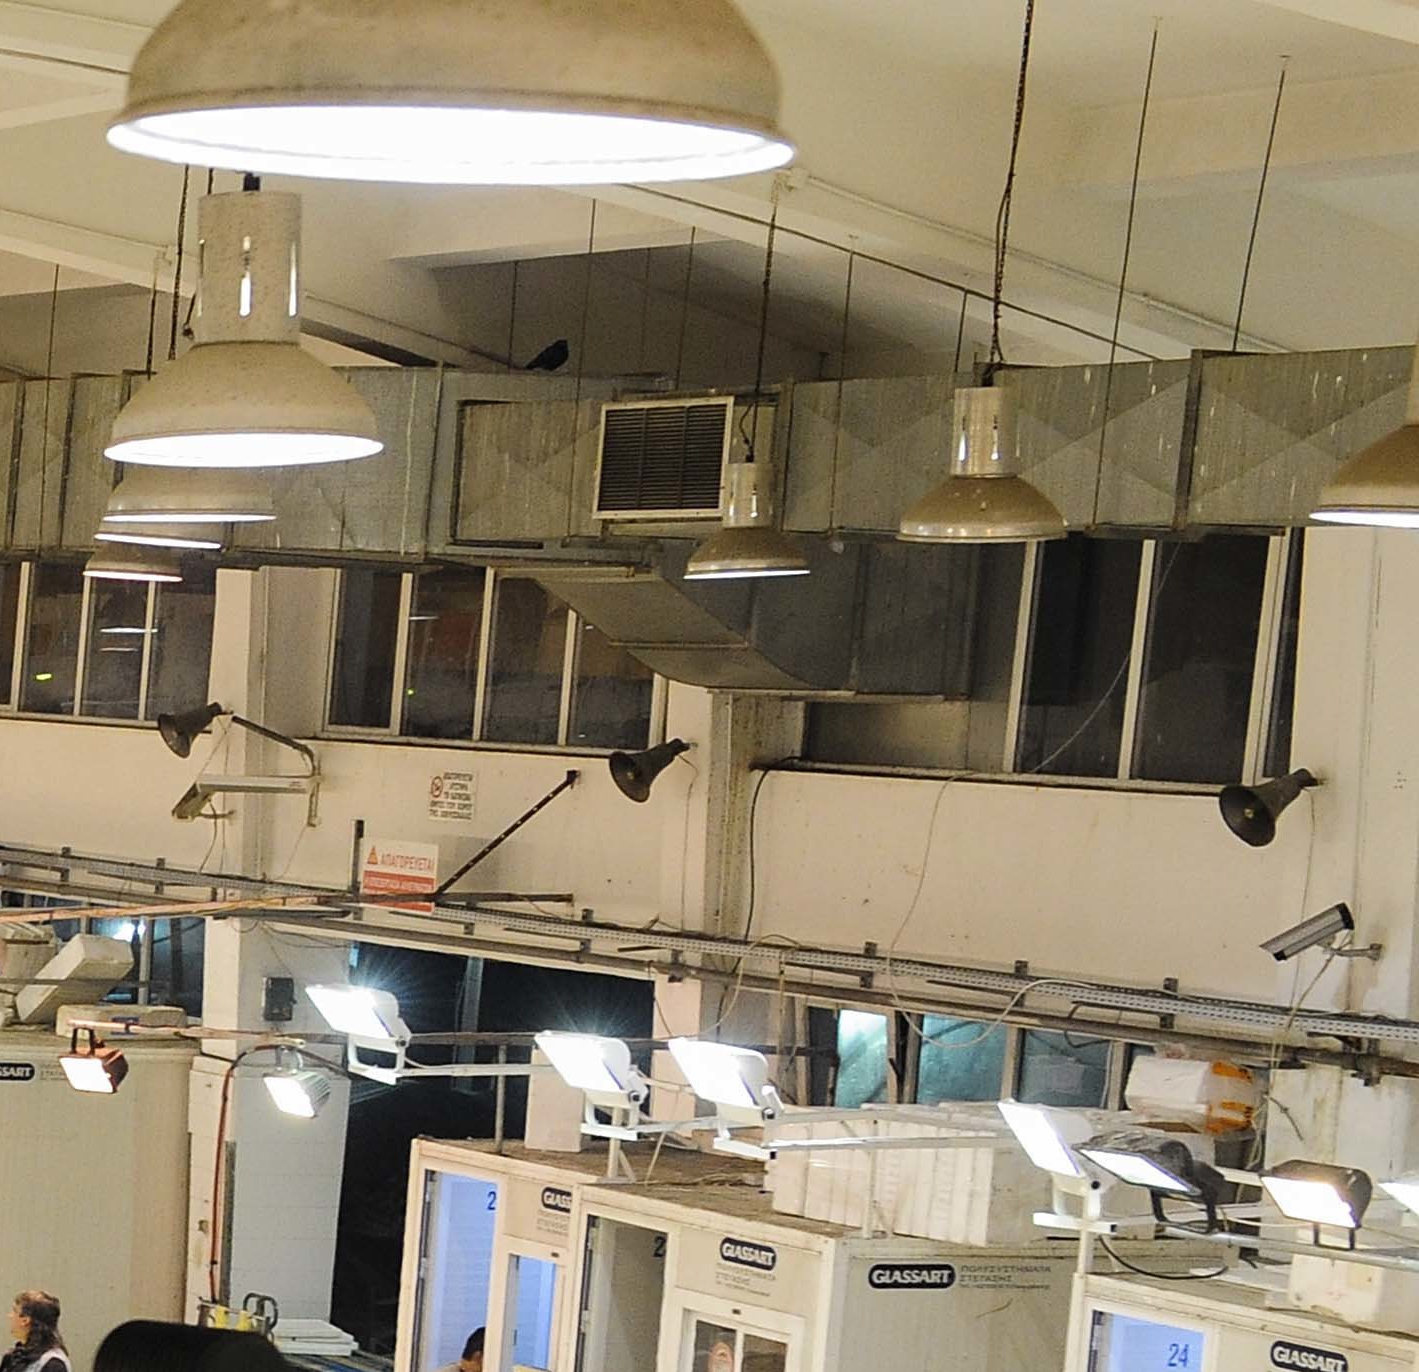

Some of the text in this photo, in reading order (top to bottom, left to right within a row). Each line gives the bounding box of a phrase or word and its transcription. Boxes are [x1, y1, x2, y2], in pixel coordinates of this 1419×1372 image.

[722, 1242, 775, 1267] GLASSART
[871, 1268, 953, 1285] GLASSART
[1167, 1343, 1189, 1367] 24
